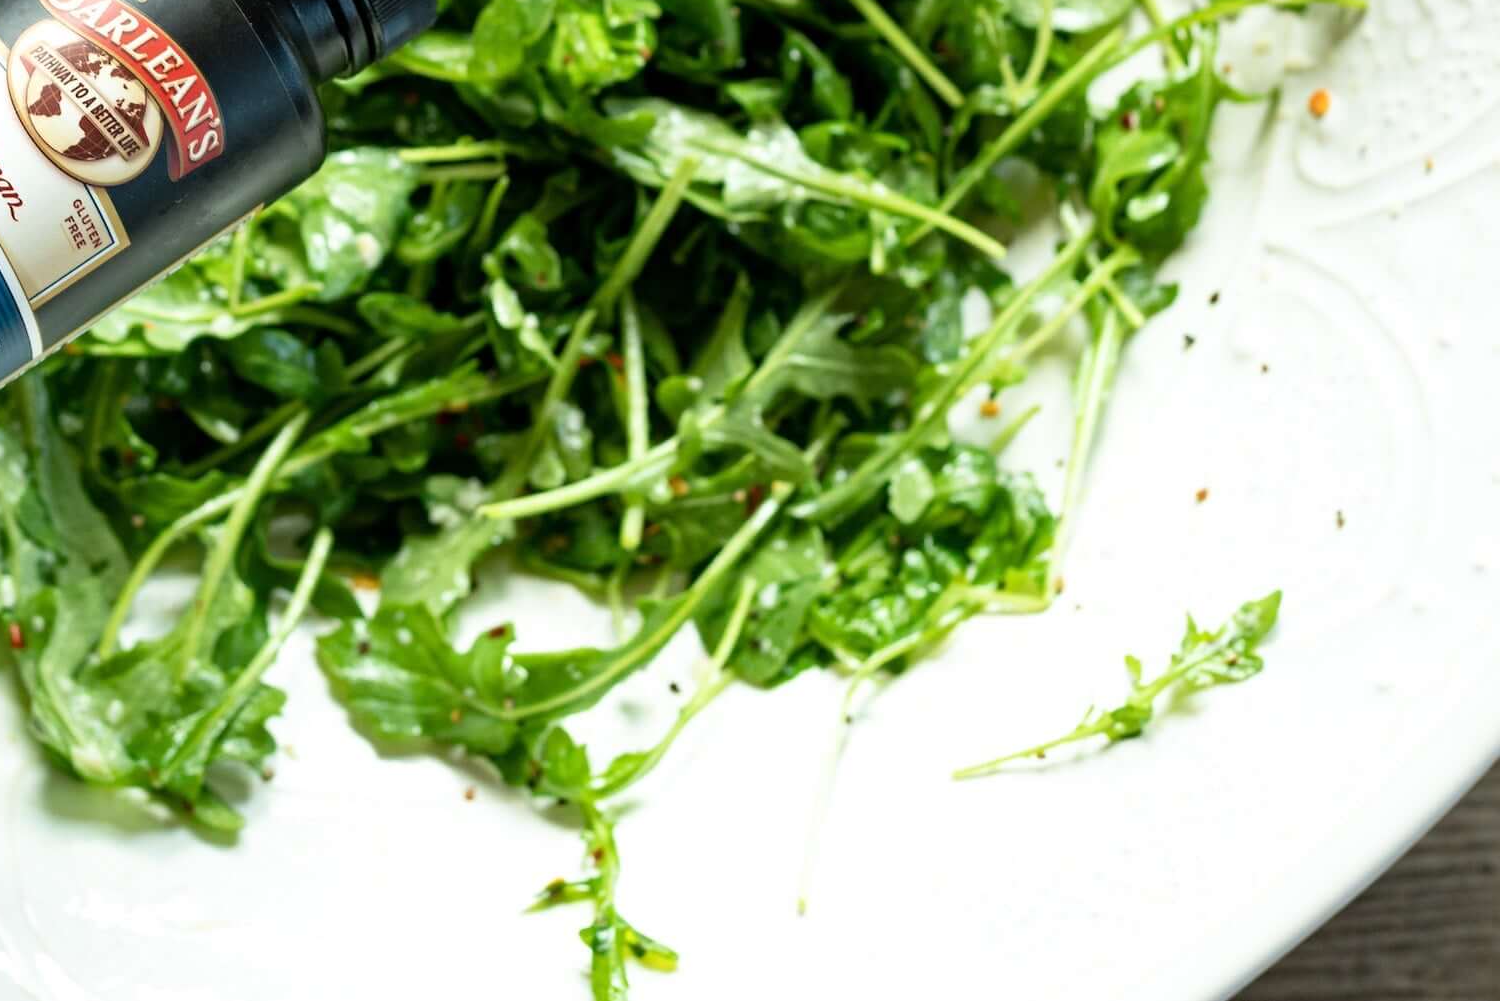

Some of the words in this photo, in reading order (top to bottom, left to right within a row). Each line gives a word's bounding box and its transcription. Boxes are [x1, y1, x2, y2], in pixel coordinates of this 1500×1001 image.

[29, 45, 77, 87] PATHWAY
[69, 81, 88, 101] TO
[80, 94, 98, 110] A
[89, 103, 125, 139] BETTER
[116, 133, 141, 157] LIFE
[63, 214, 87, 250] FREE
[71, 197, 103, 248] GLUTEN
